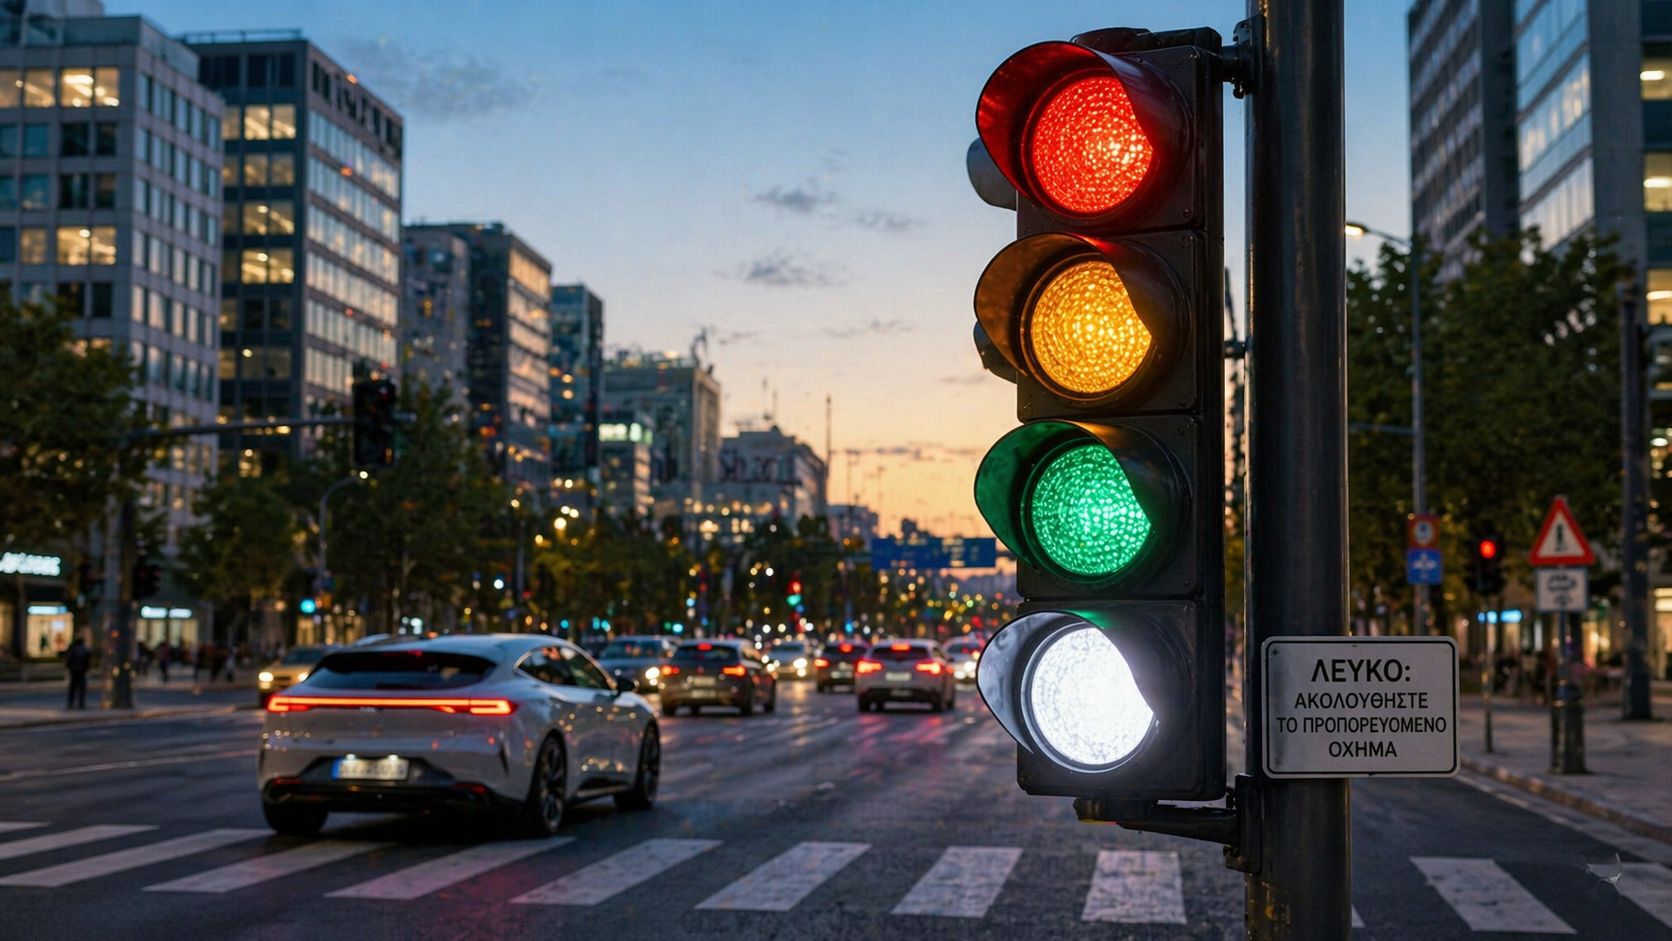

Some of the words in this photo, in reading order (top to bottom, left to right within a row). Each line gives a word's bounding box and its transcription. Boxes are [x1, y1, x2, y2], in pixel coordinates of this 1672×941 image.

[1311, 659, 1411, 682] ΛΕΥΚΟ:
[1294, 692, 1428, 709] ΑΚΟΛΟΥΘΗΣΤΕ
[1276, 717, 1298, 733] ΤΟ
[1303, 717, 1447, 733] ΠΡΟΠΟΡΕΥΟΜΕΝΟ
[1328, 741, 1398, 757] ΟΧΗΜΑ
